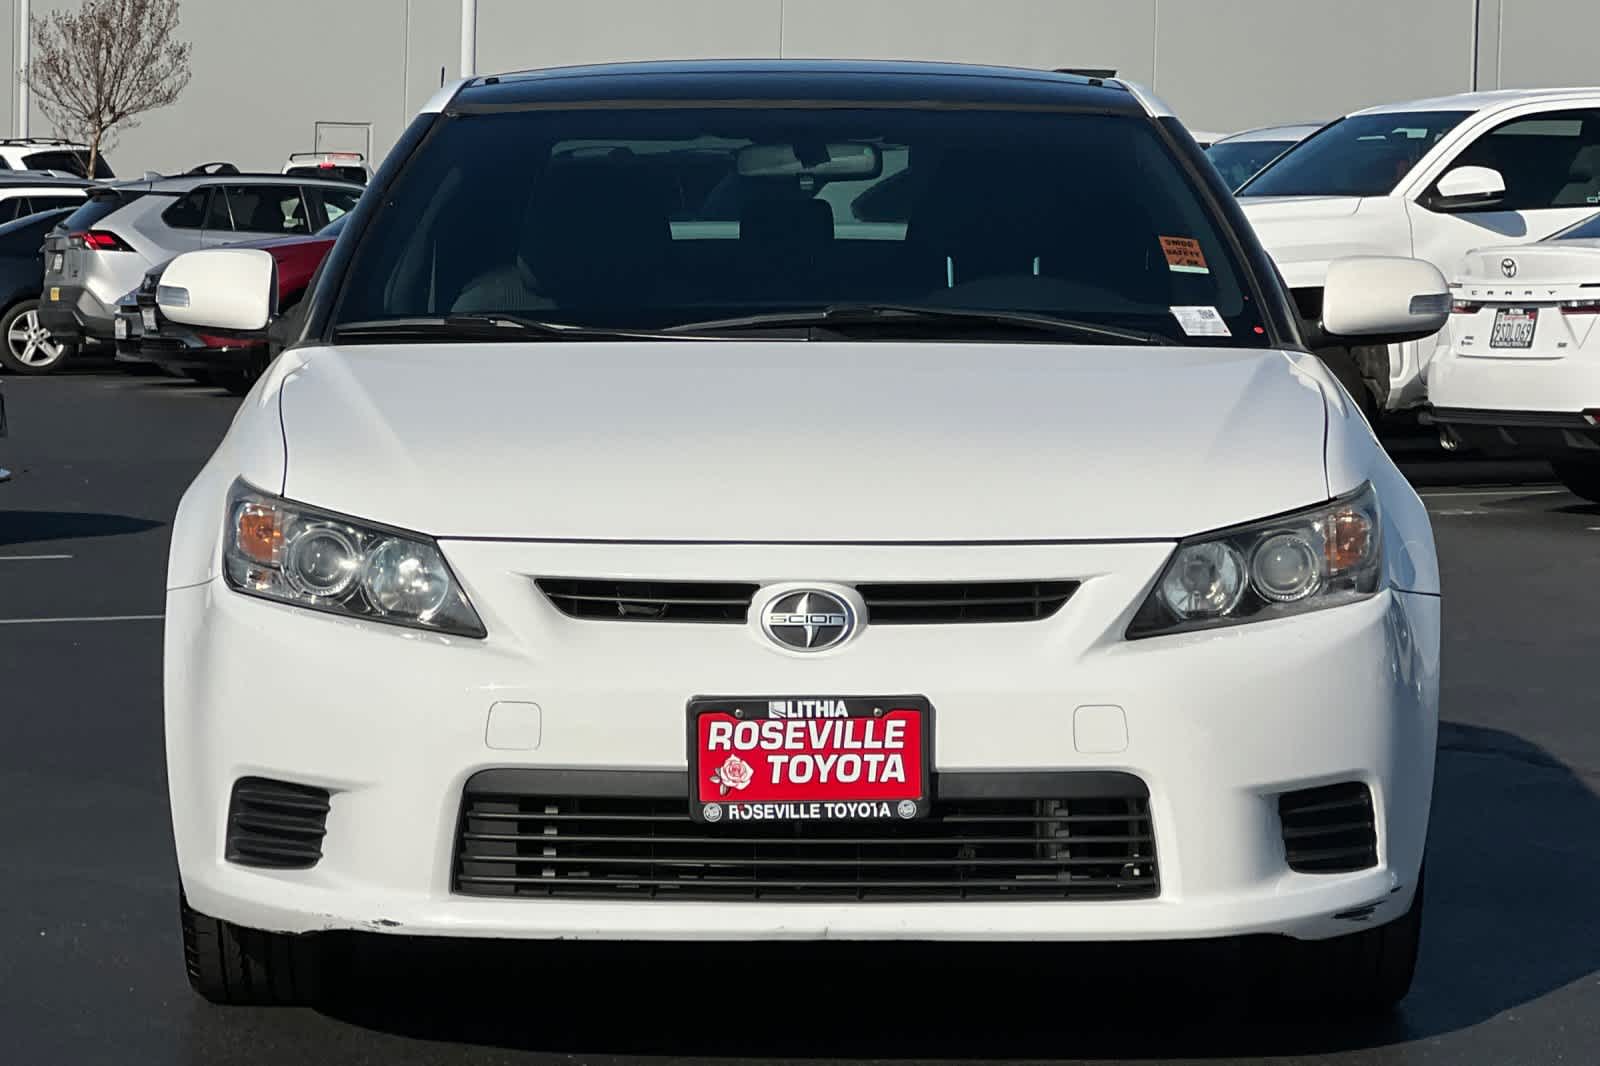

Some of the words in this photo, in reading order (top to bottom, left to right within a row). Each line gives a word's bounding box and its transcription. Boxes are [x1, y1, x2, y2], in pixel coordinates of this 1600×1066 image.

[770, 615, 846, 624] SCION
[787, 700, 849, 719] LITHIA
[707, 719, 906, 751] ROSEVILLE
[767, 753, 906, 785] TOYOTA
[728, 803, 821, 820] ROSEVILLE
[824, 802, 892, 819] TOYOTA
